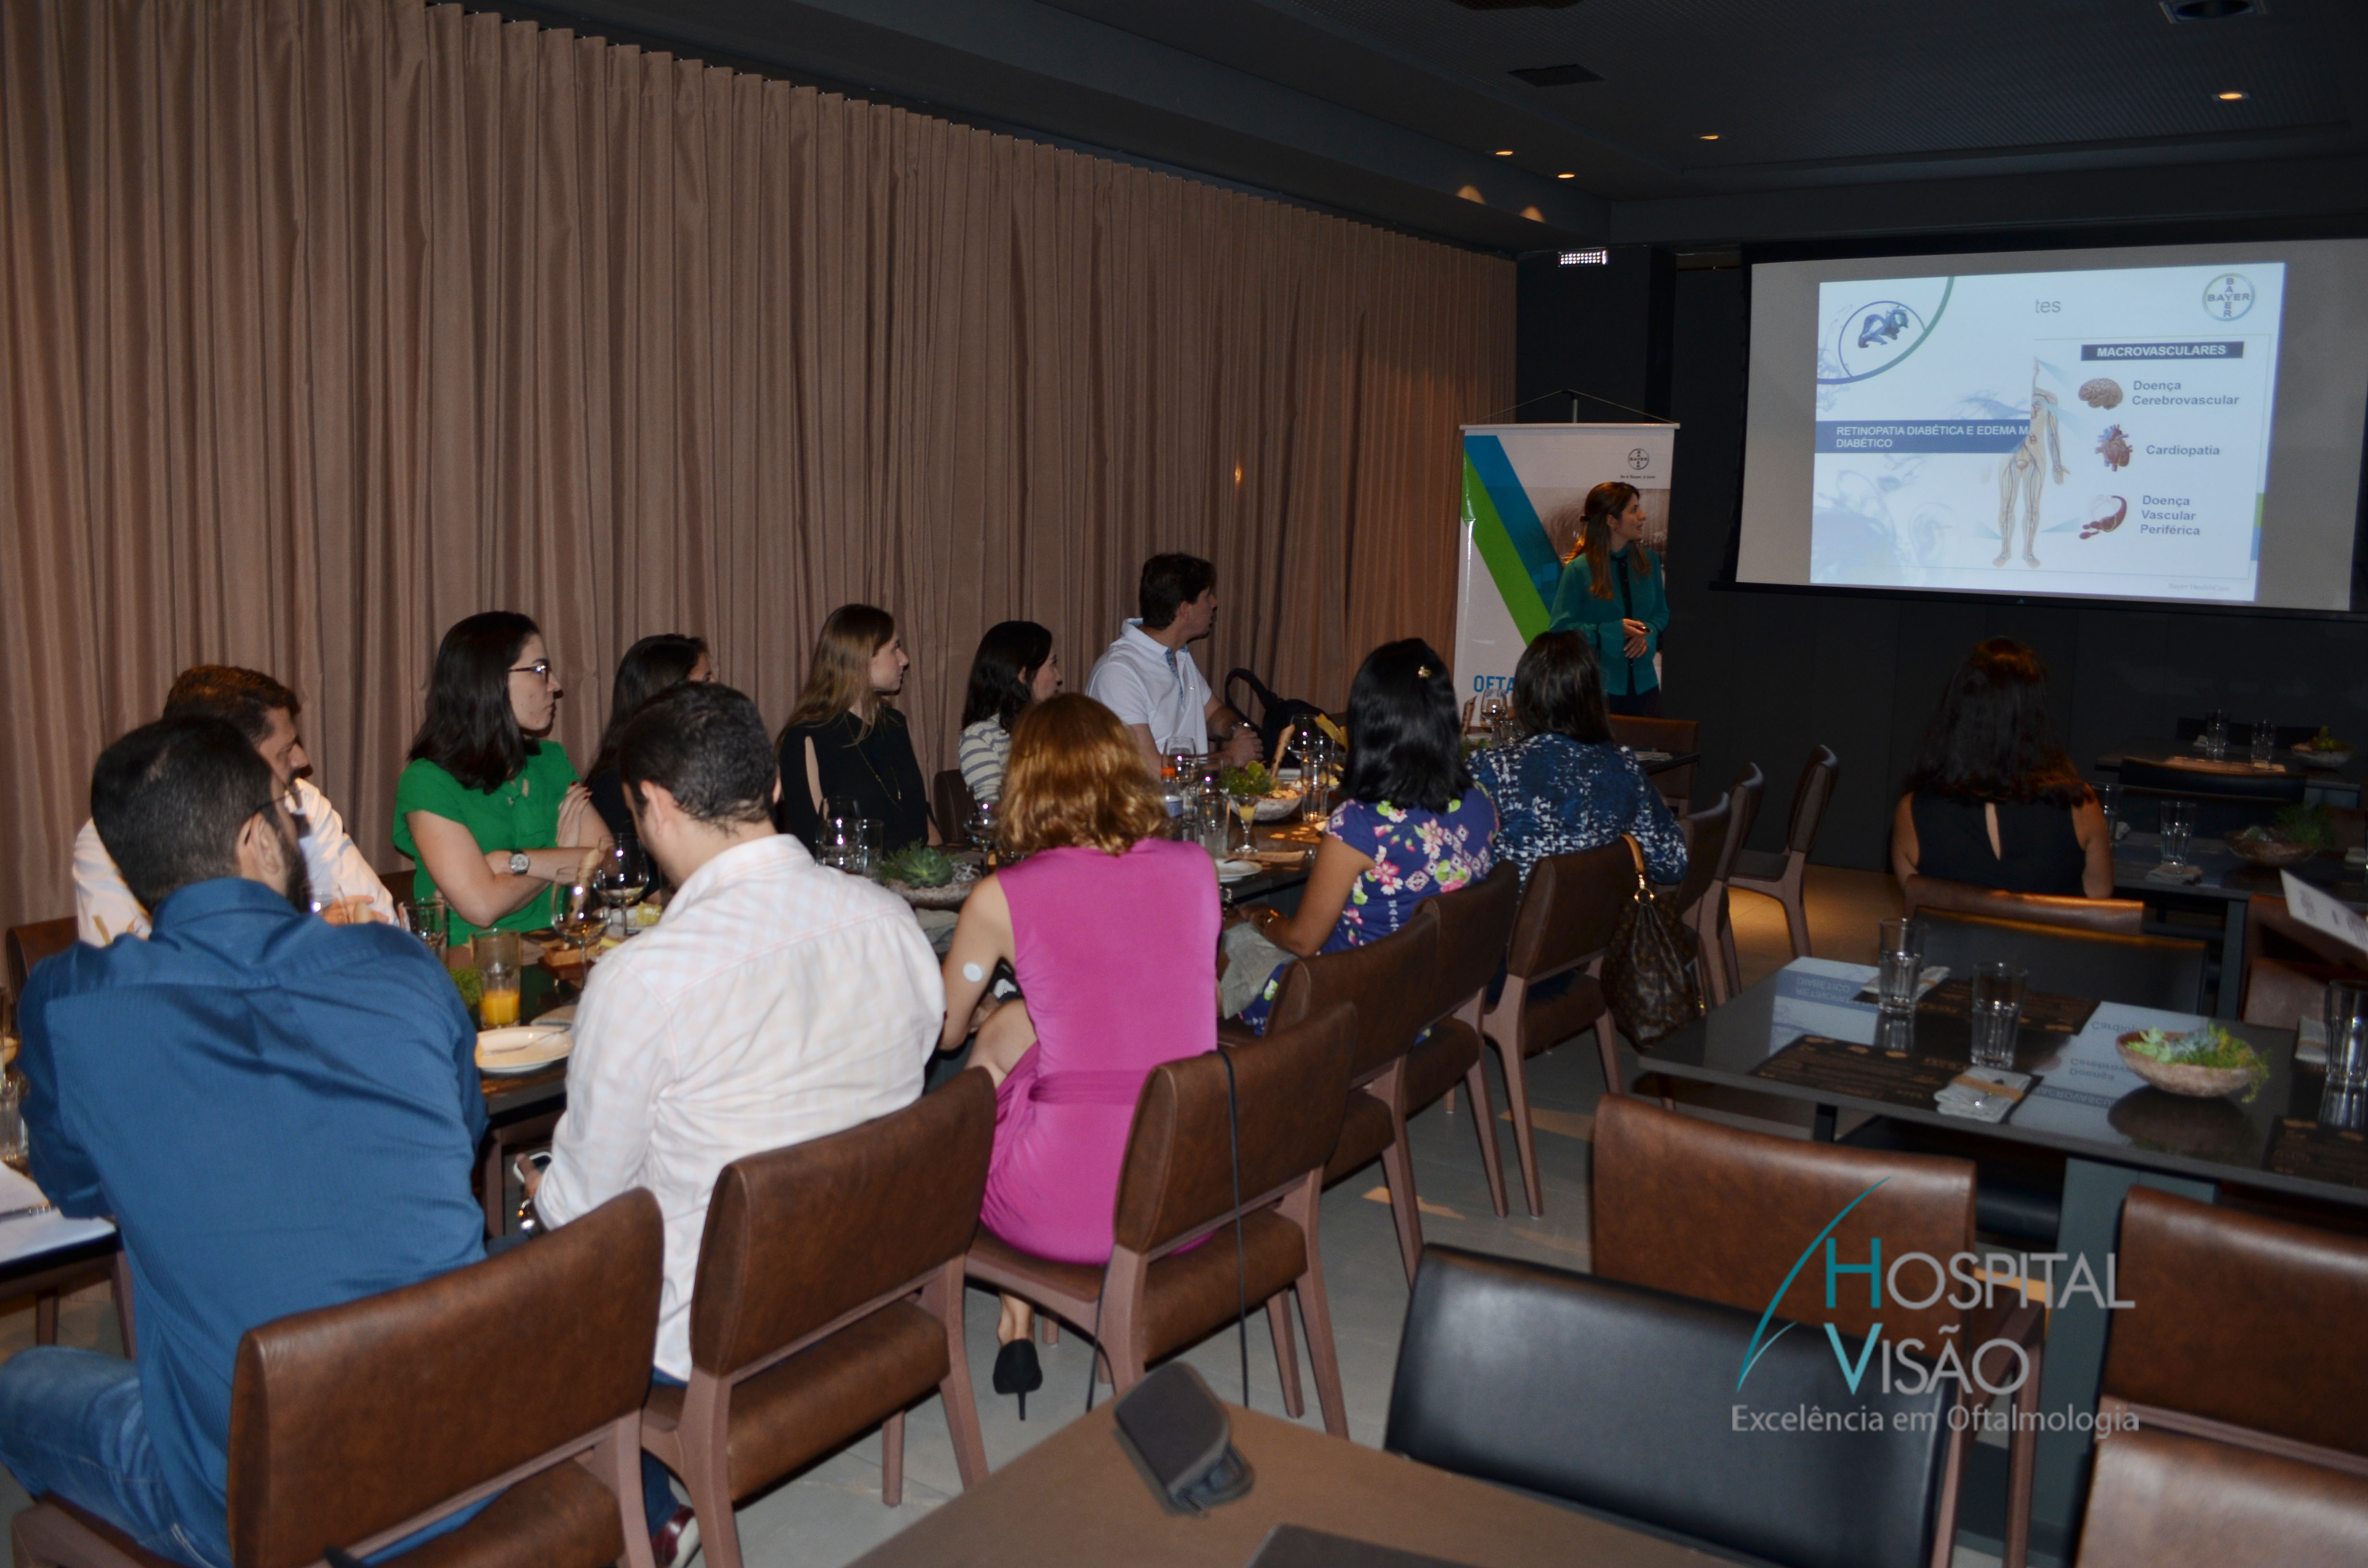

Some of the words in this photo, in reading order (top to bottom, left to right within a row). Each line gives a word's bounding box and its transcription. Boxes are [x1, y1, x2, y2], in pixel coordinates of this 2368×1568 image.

[2207, 293, 2250, 301] BAYER
[2097, 345, 2226, 357] MACROVASCULARES
[2133, 380, 2181, 391] Doença
[2132, 395, 2240, 404] Cerebrovascular
[1837, 427, 1905, 436] RETINOPATIA
[1907, 425, 1964, 435] DIABÉTICA
[1967, 426, 1973, 435] E
[1976, 426, 2017, 435] EDEMA
[2019, 426, 2030, 435] M
[1836, 438, 1893, 448] DIABÉTICO
[2146, 445, 2220, 457] Cardiopatia
[2142, 495, 2190, 507] Doença
[2141, 510, 2196, 520] Vascular
[2140, 524, 2200, 535] Periférica
